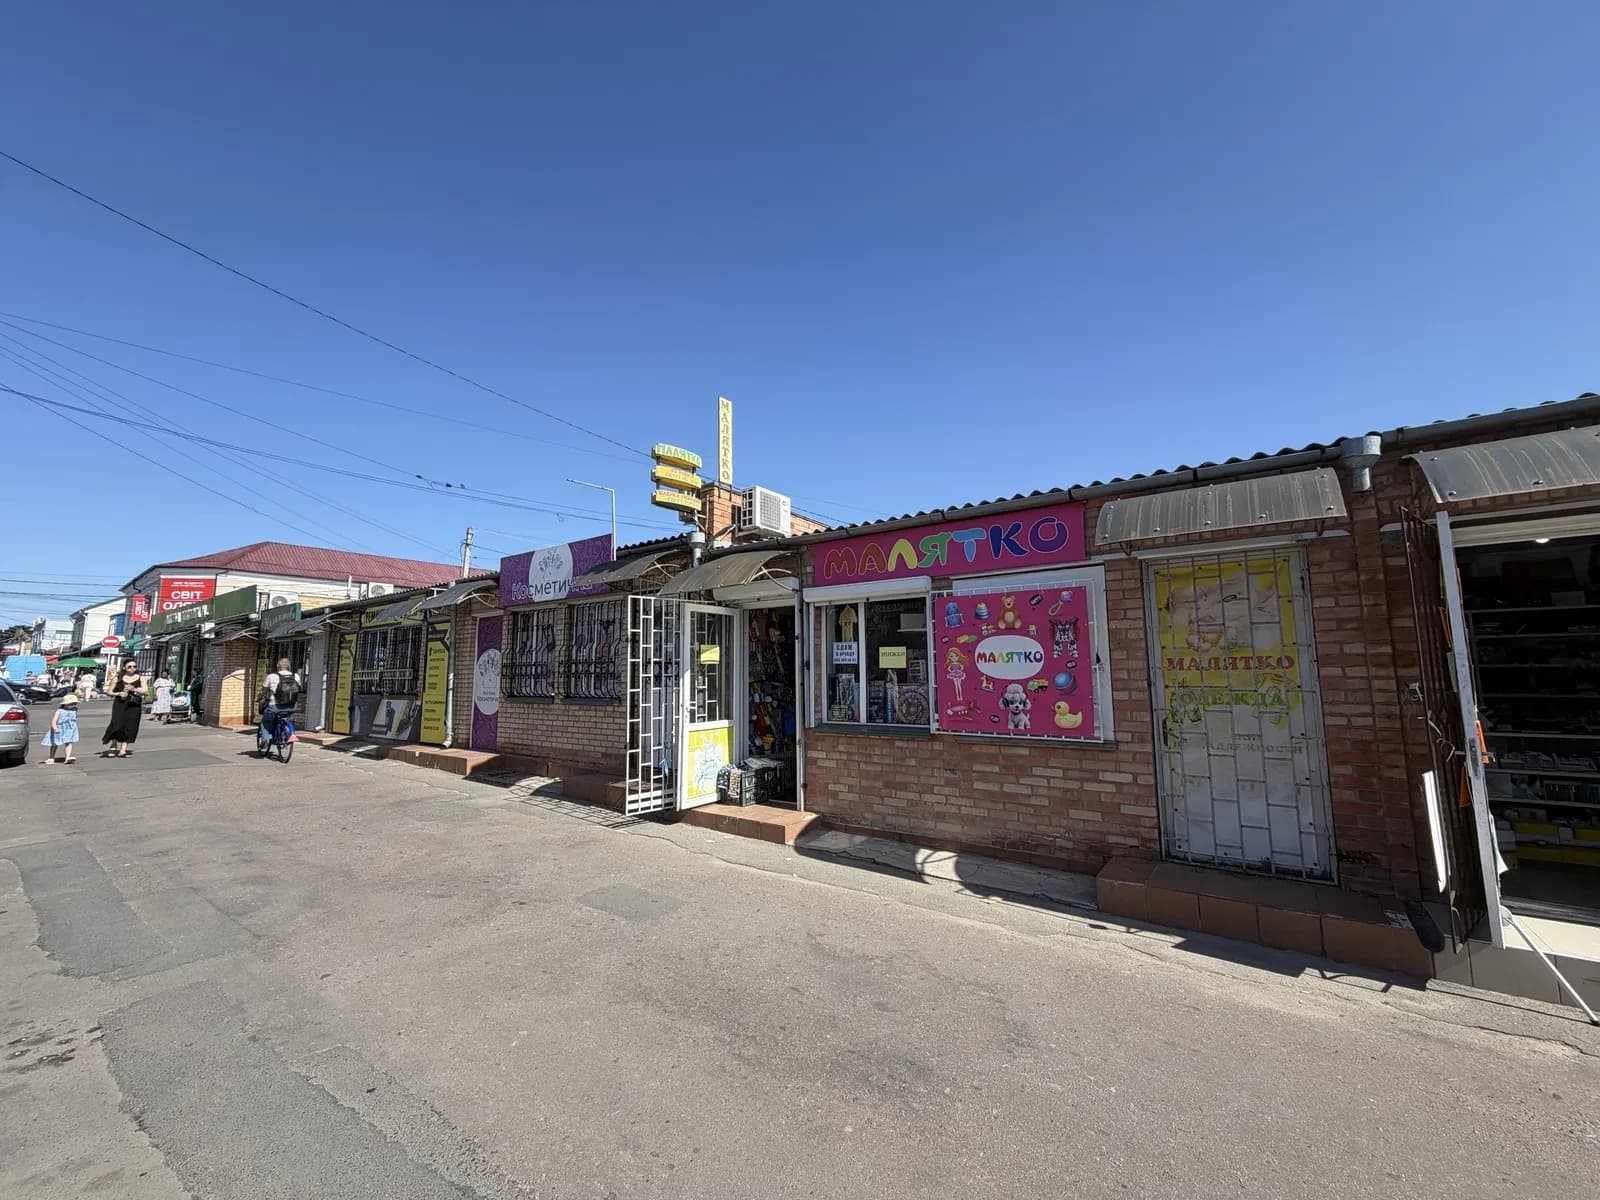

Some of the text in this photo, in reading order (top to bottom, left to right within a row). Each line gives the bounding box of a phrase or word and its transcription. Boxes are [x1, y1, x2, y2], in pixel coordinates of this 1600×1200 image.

[721, 400, 730, 480] МАЛЯТКО
[824, 517, 1068, 579] МАЛЯТКО
[171, 591, 204, 600] СВІТ
[977, 651, 1043, 664] МАЛЯТКО
[1166, 655, 1296, 672] МАЛЯТКО
